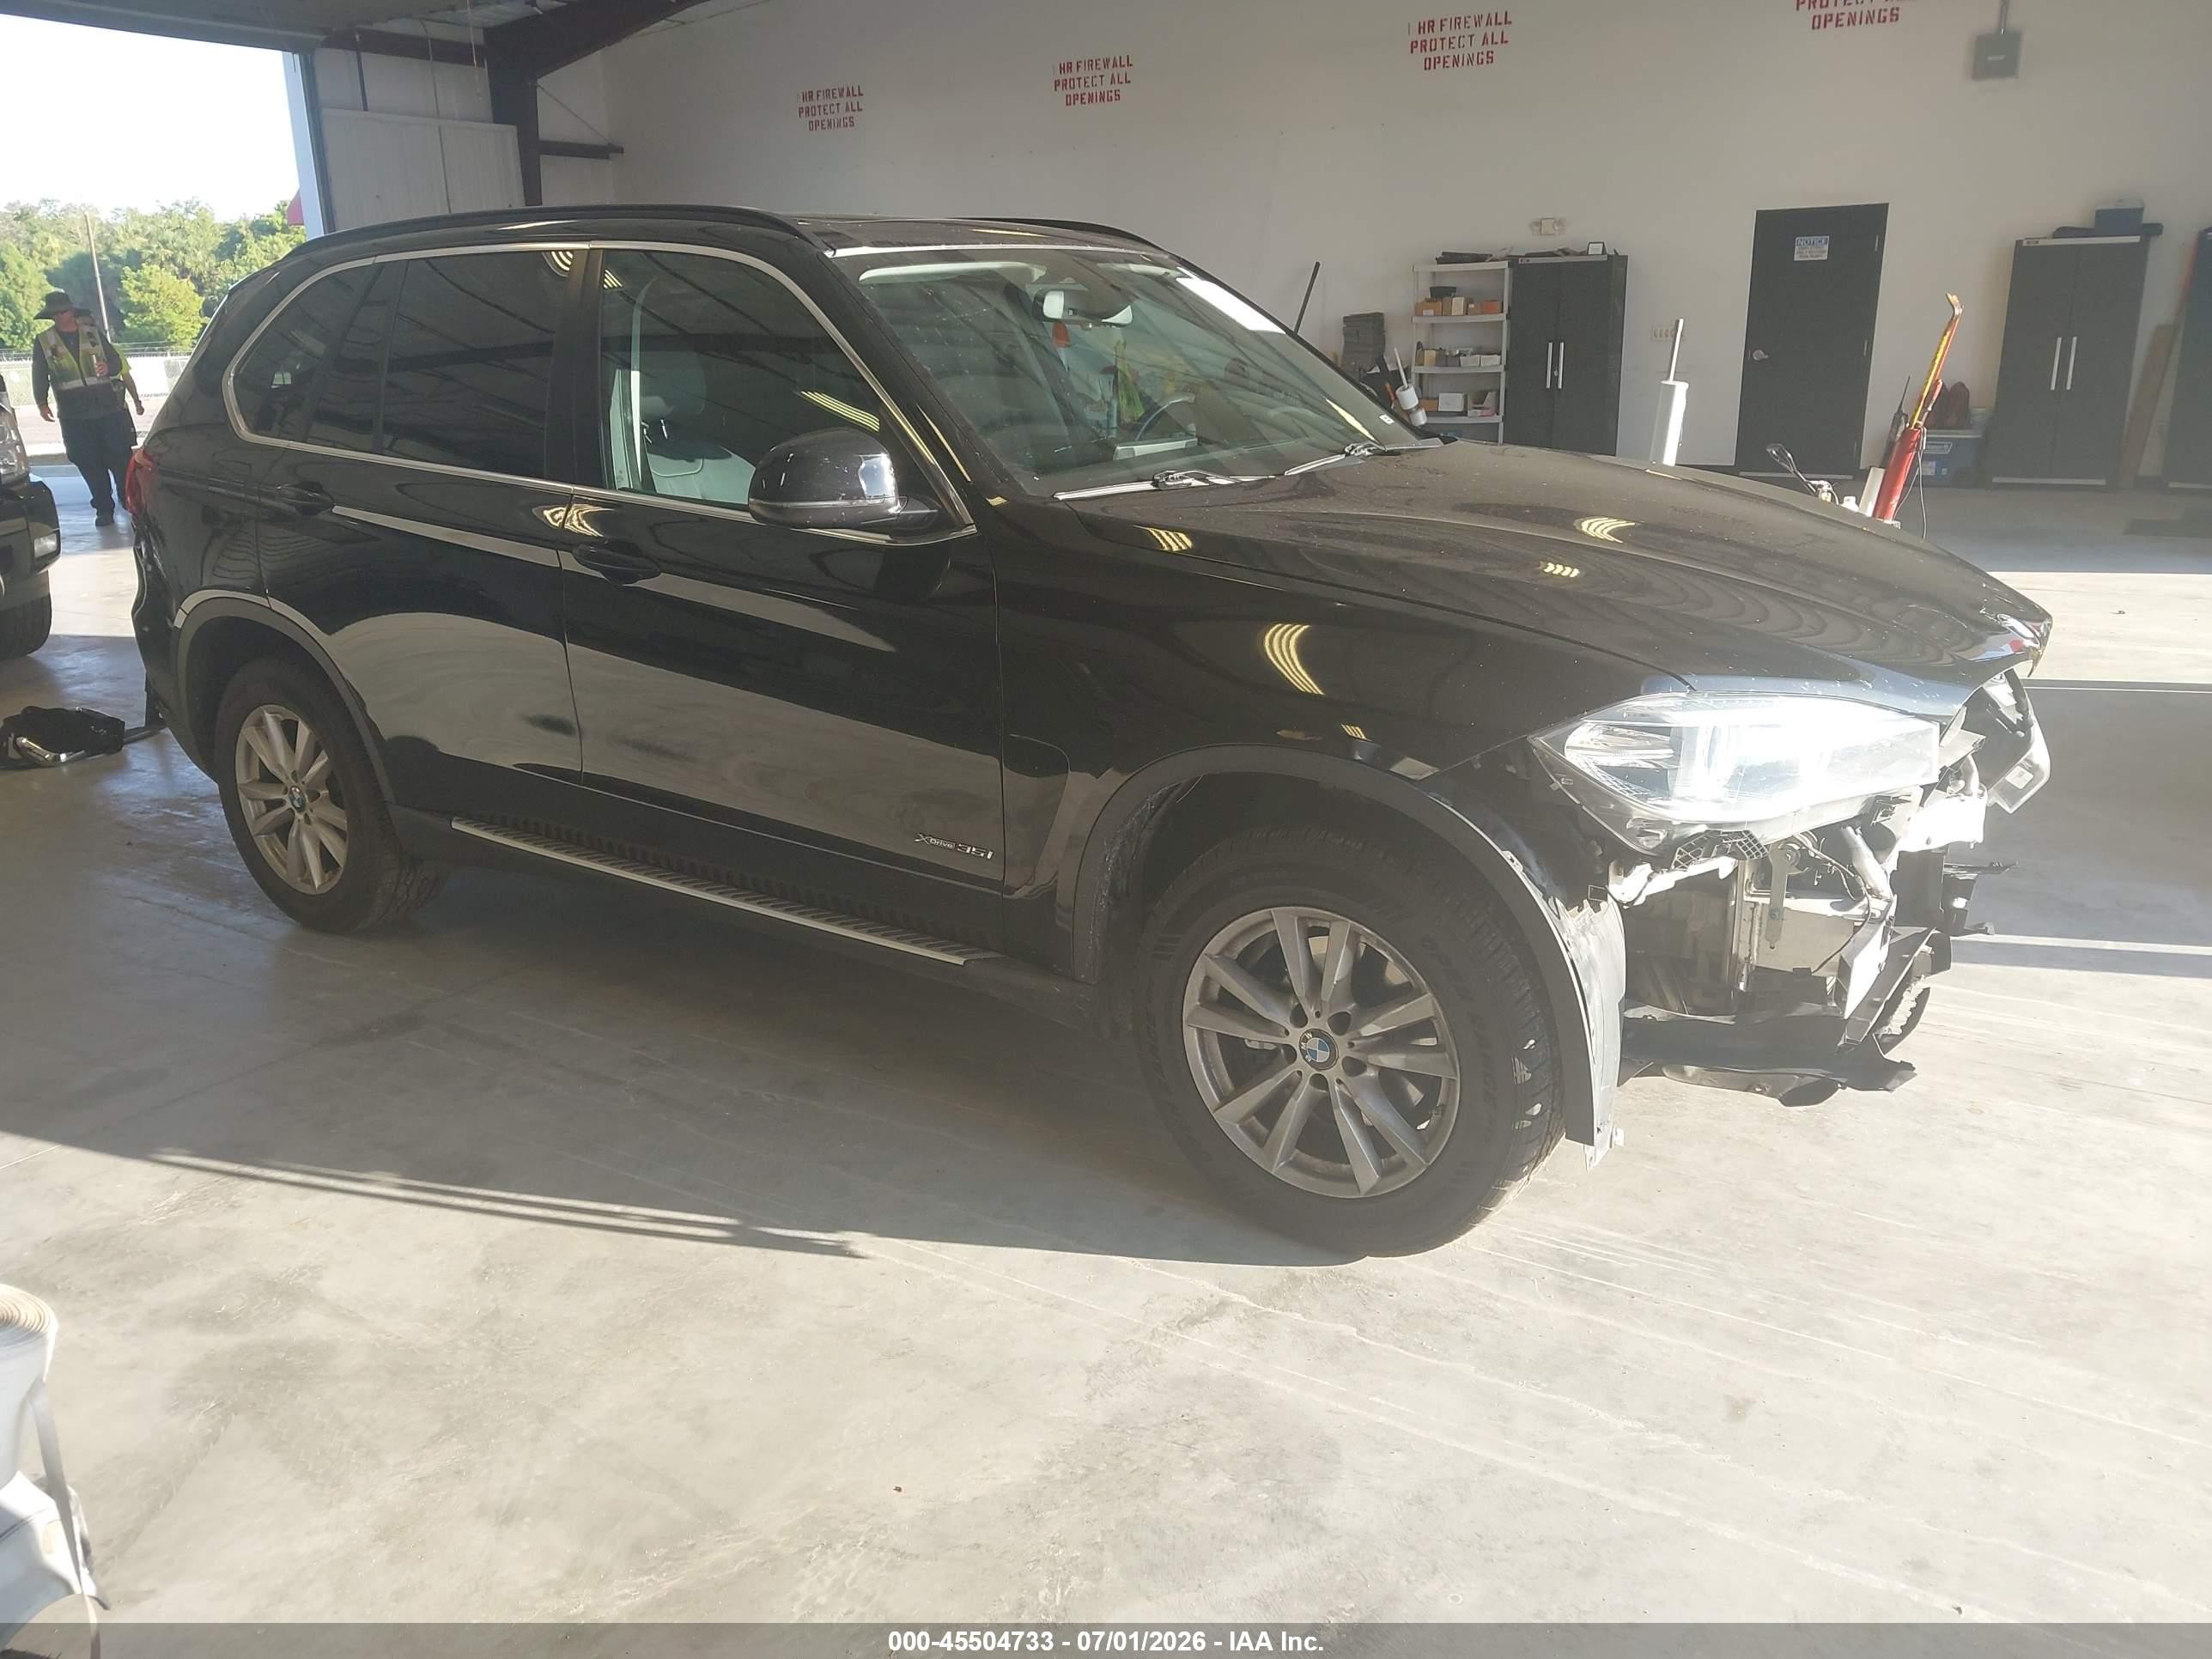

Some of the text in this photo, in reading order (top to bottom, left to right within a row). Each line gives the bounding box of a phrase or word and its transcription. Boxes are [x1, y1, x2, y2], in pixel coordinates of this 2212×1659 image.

[1418, 18, 1436, 35] HR
[1439, 10, 1512, 32] FIREWALL
[1811, 6, 1900, 31] OPENINGS
[1410, 31, 1509, 55] PROTECT ALL
[1059, 61, 1073, 75] HR
[1076, 54, 1134, 73] FIREWALL
[1424, 50, 1495, 71] OPENINGS
[1054, 71, 1132, 92] PROTECT ALL
[816, 84, 865, 102] FIREWALL
[1065, 88, 1121, 107] OPENINGS
[798, 100, 864, 119] PROTECT ALL
[808, 116, 855, 132] OPENINGS
[1300, 1031, 1313, 1062] BMW
